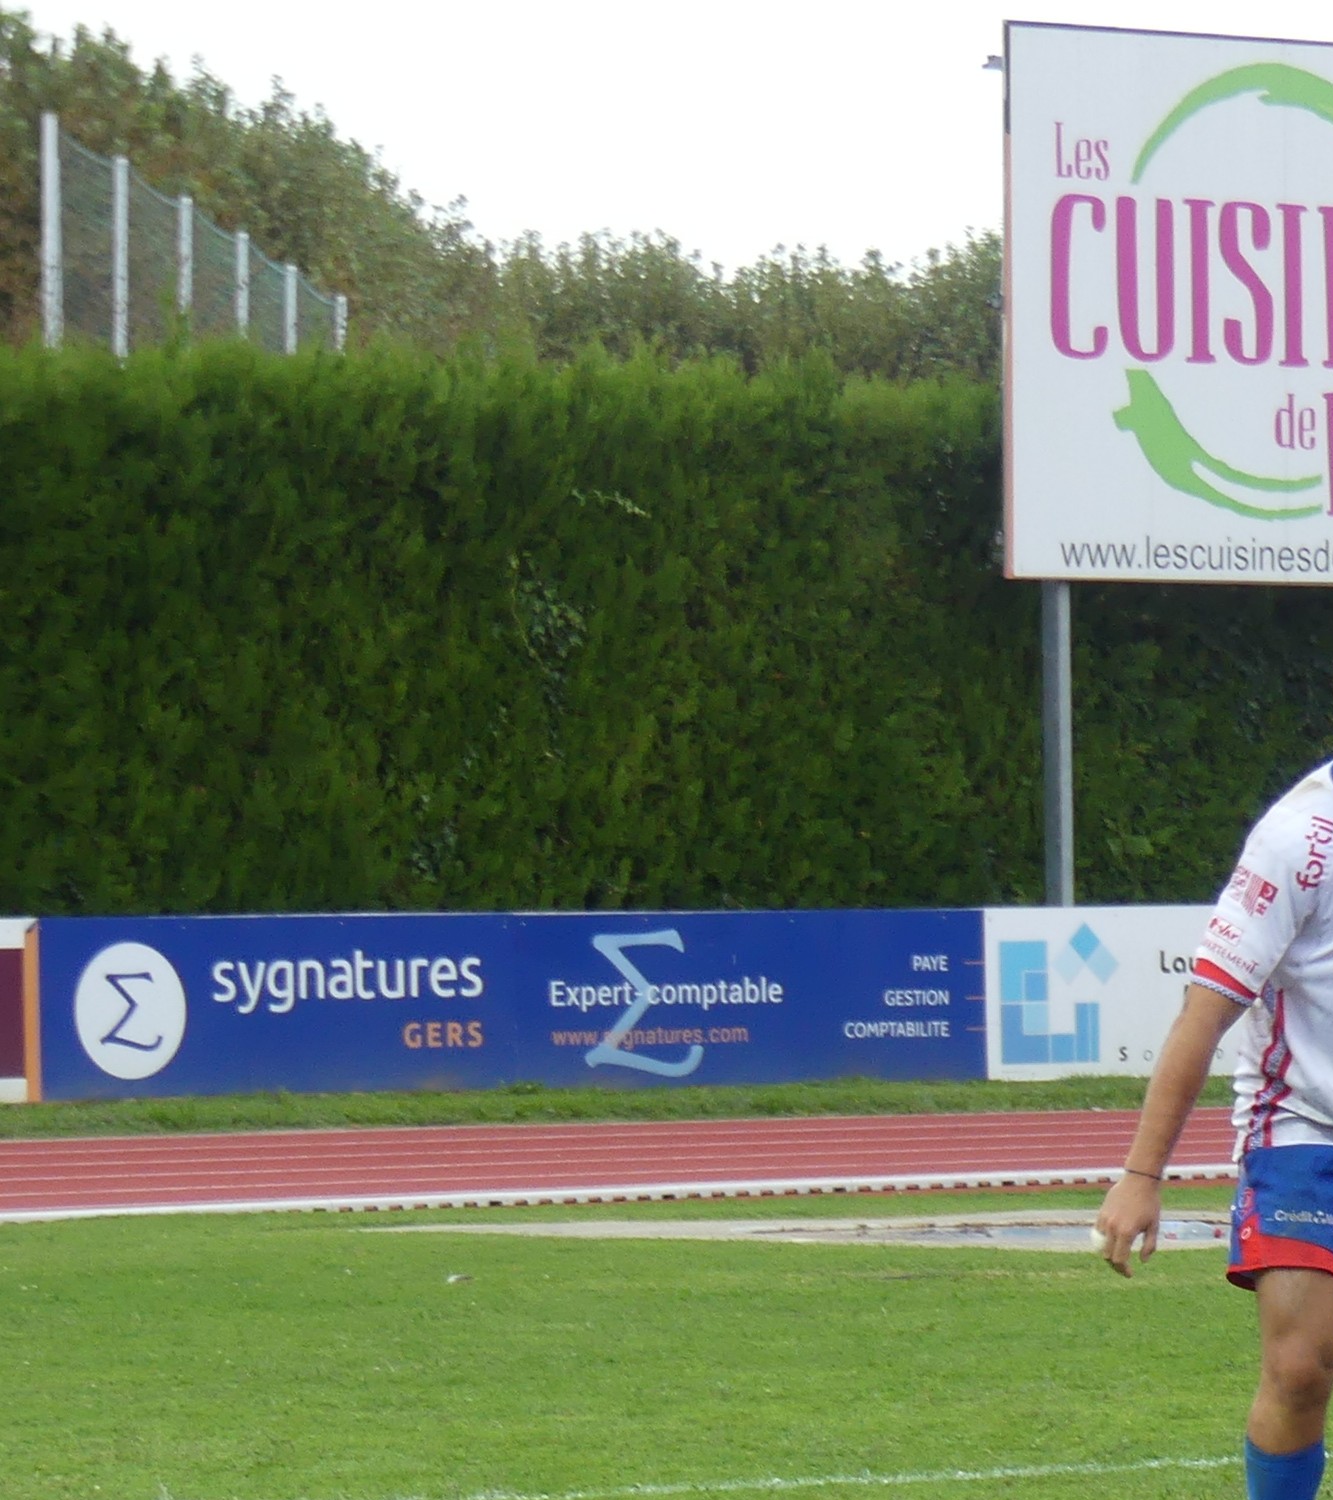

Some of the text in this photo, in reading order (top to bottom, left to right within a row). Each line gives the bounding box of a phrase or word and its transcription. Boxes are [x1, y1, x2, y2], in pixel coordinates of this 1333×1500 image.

[1053, 121, 1111, 181] Les
[1274, 392, 1316, 450] de
[911, 954, 950, 973] PAYE
[211, 948, 484, 1015] sygnatures
[548, 975, 784, 1012] Expert-comptable
[884, 989, 951, 1009] GESTION
[402, 1020, 484, 1050] GERS
[843, 1019, 951, 1040] COMPTABILITE
